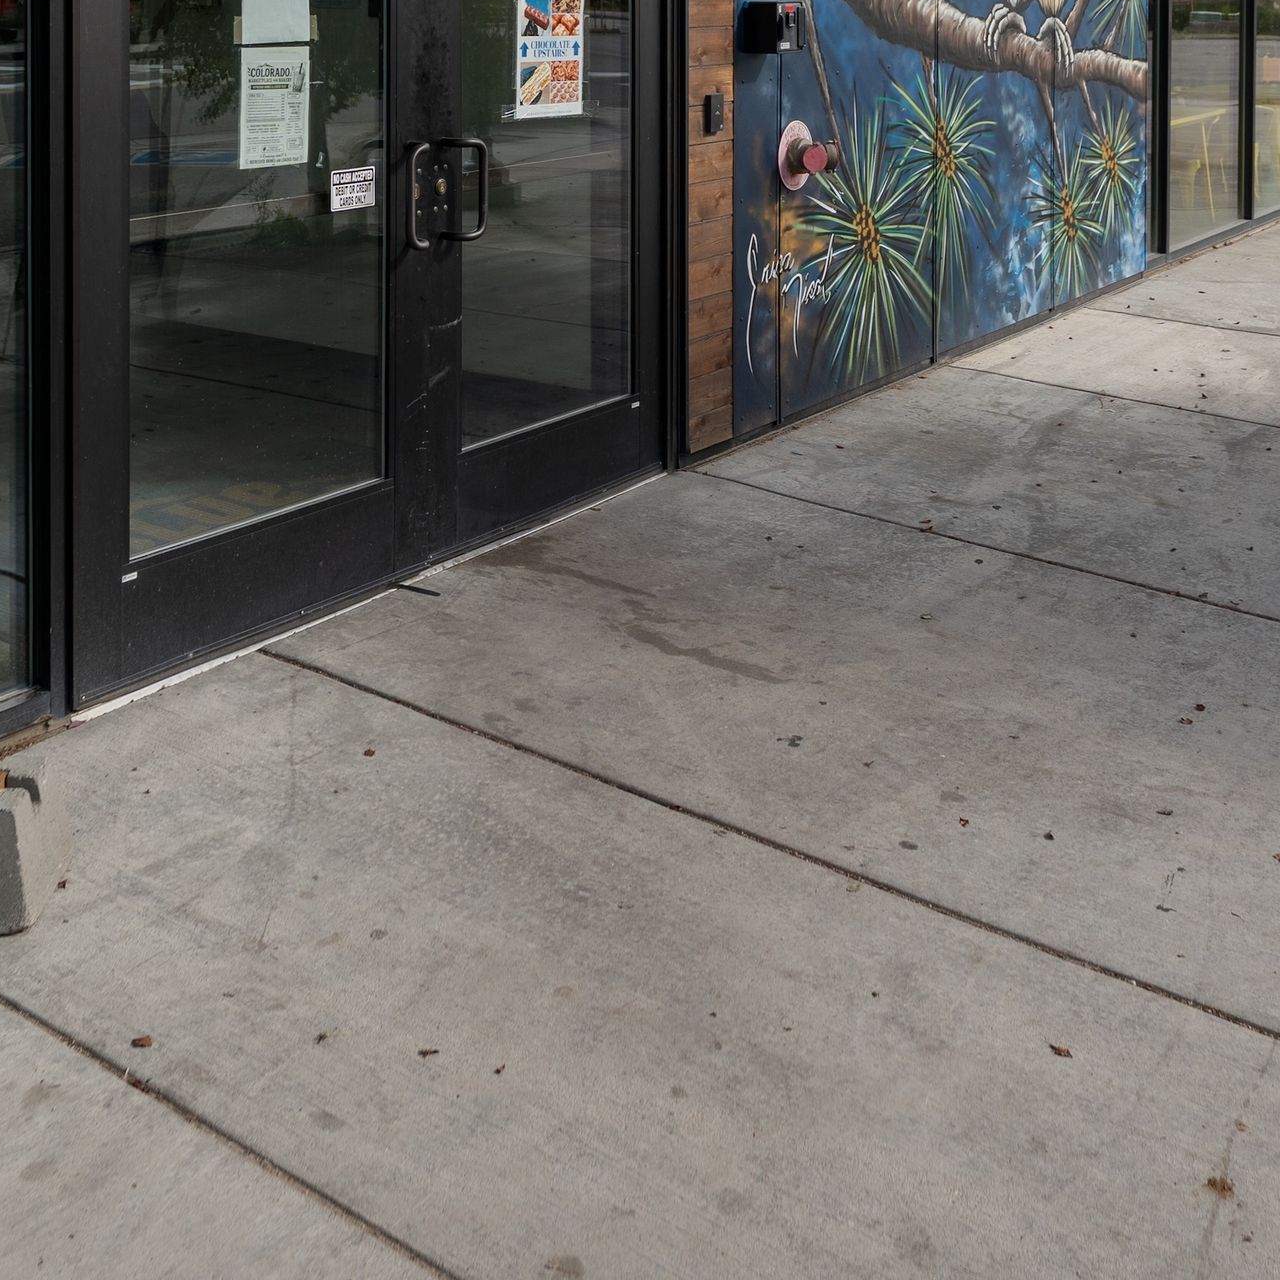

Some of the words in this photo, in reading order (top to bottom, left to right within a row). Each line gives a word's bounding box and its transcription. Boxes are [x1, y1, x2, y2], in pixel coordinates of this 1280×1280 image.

[530, 40, 570, 50] CHOCOLATE
[533, 48, 568, 58] UPSTAIRS!
[251, 67, 290, 78] COLORADO
[333, 173, 340, 184] NO
[340, 172, 352, 183] CASH
[352, 170, 373, 181] ACCEPTED
[336, 186, 348, 196] DEBIT
[350, 185, 355, 194] OR
[356, 183, 371, 193] CREDIT
[340, 196, 354, 206] CARDS
[355, 194, 367, 204] ONLY
